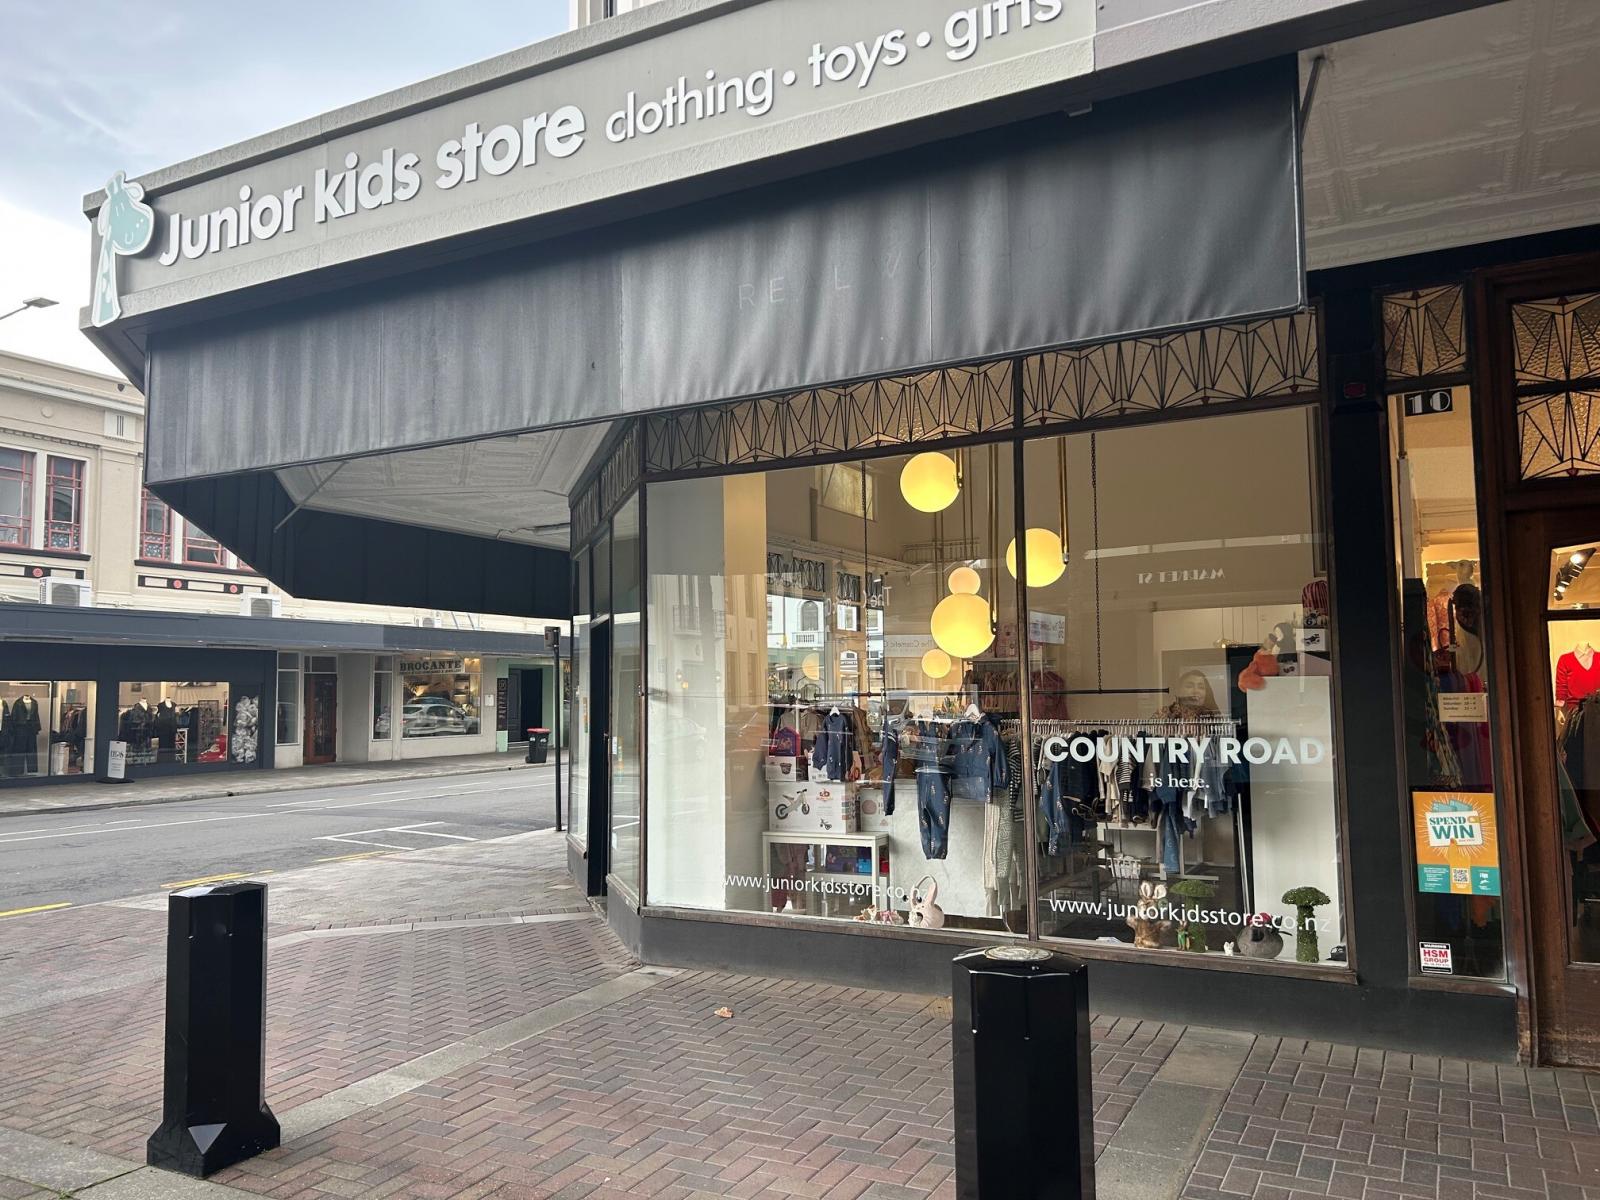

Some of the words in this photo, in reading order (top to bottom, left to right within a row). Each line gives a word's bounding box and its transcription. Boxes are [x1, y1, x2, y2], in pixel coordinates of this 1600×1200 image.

[158, 185, 304, 266] Junior
[314, 151, 420, 224] kids
[435, 104, 586, 189] store
[605, 69, 774, 144] clothing
[808, 27, 908, 89] toys
[1409, 391, 1451, 414] 10
[1044, 736, 1212, 764] COUNTRY
[1220, 737, 1325, 765] ROAD
[1149, 772, 1163, 788] is
[1167, 773, 1210, 789] here.
[1429, 816, 1467, 825] SPEND
[1432, 825, 1475, 839] WIN
[1423, 949, 1449, 958] HSM
